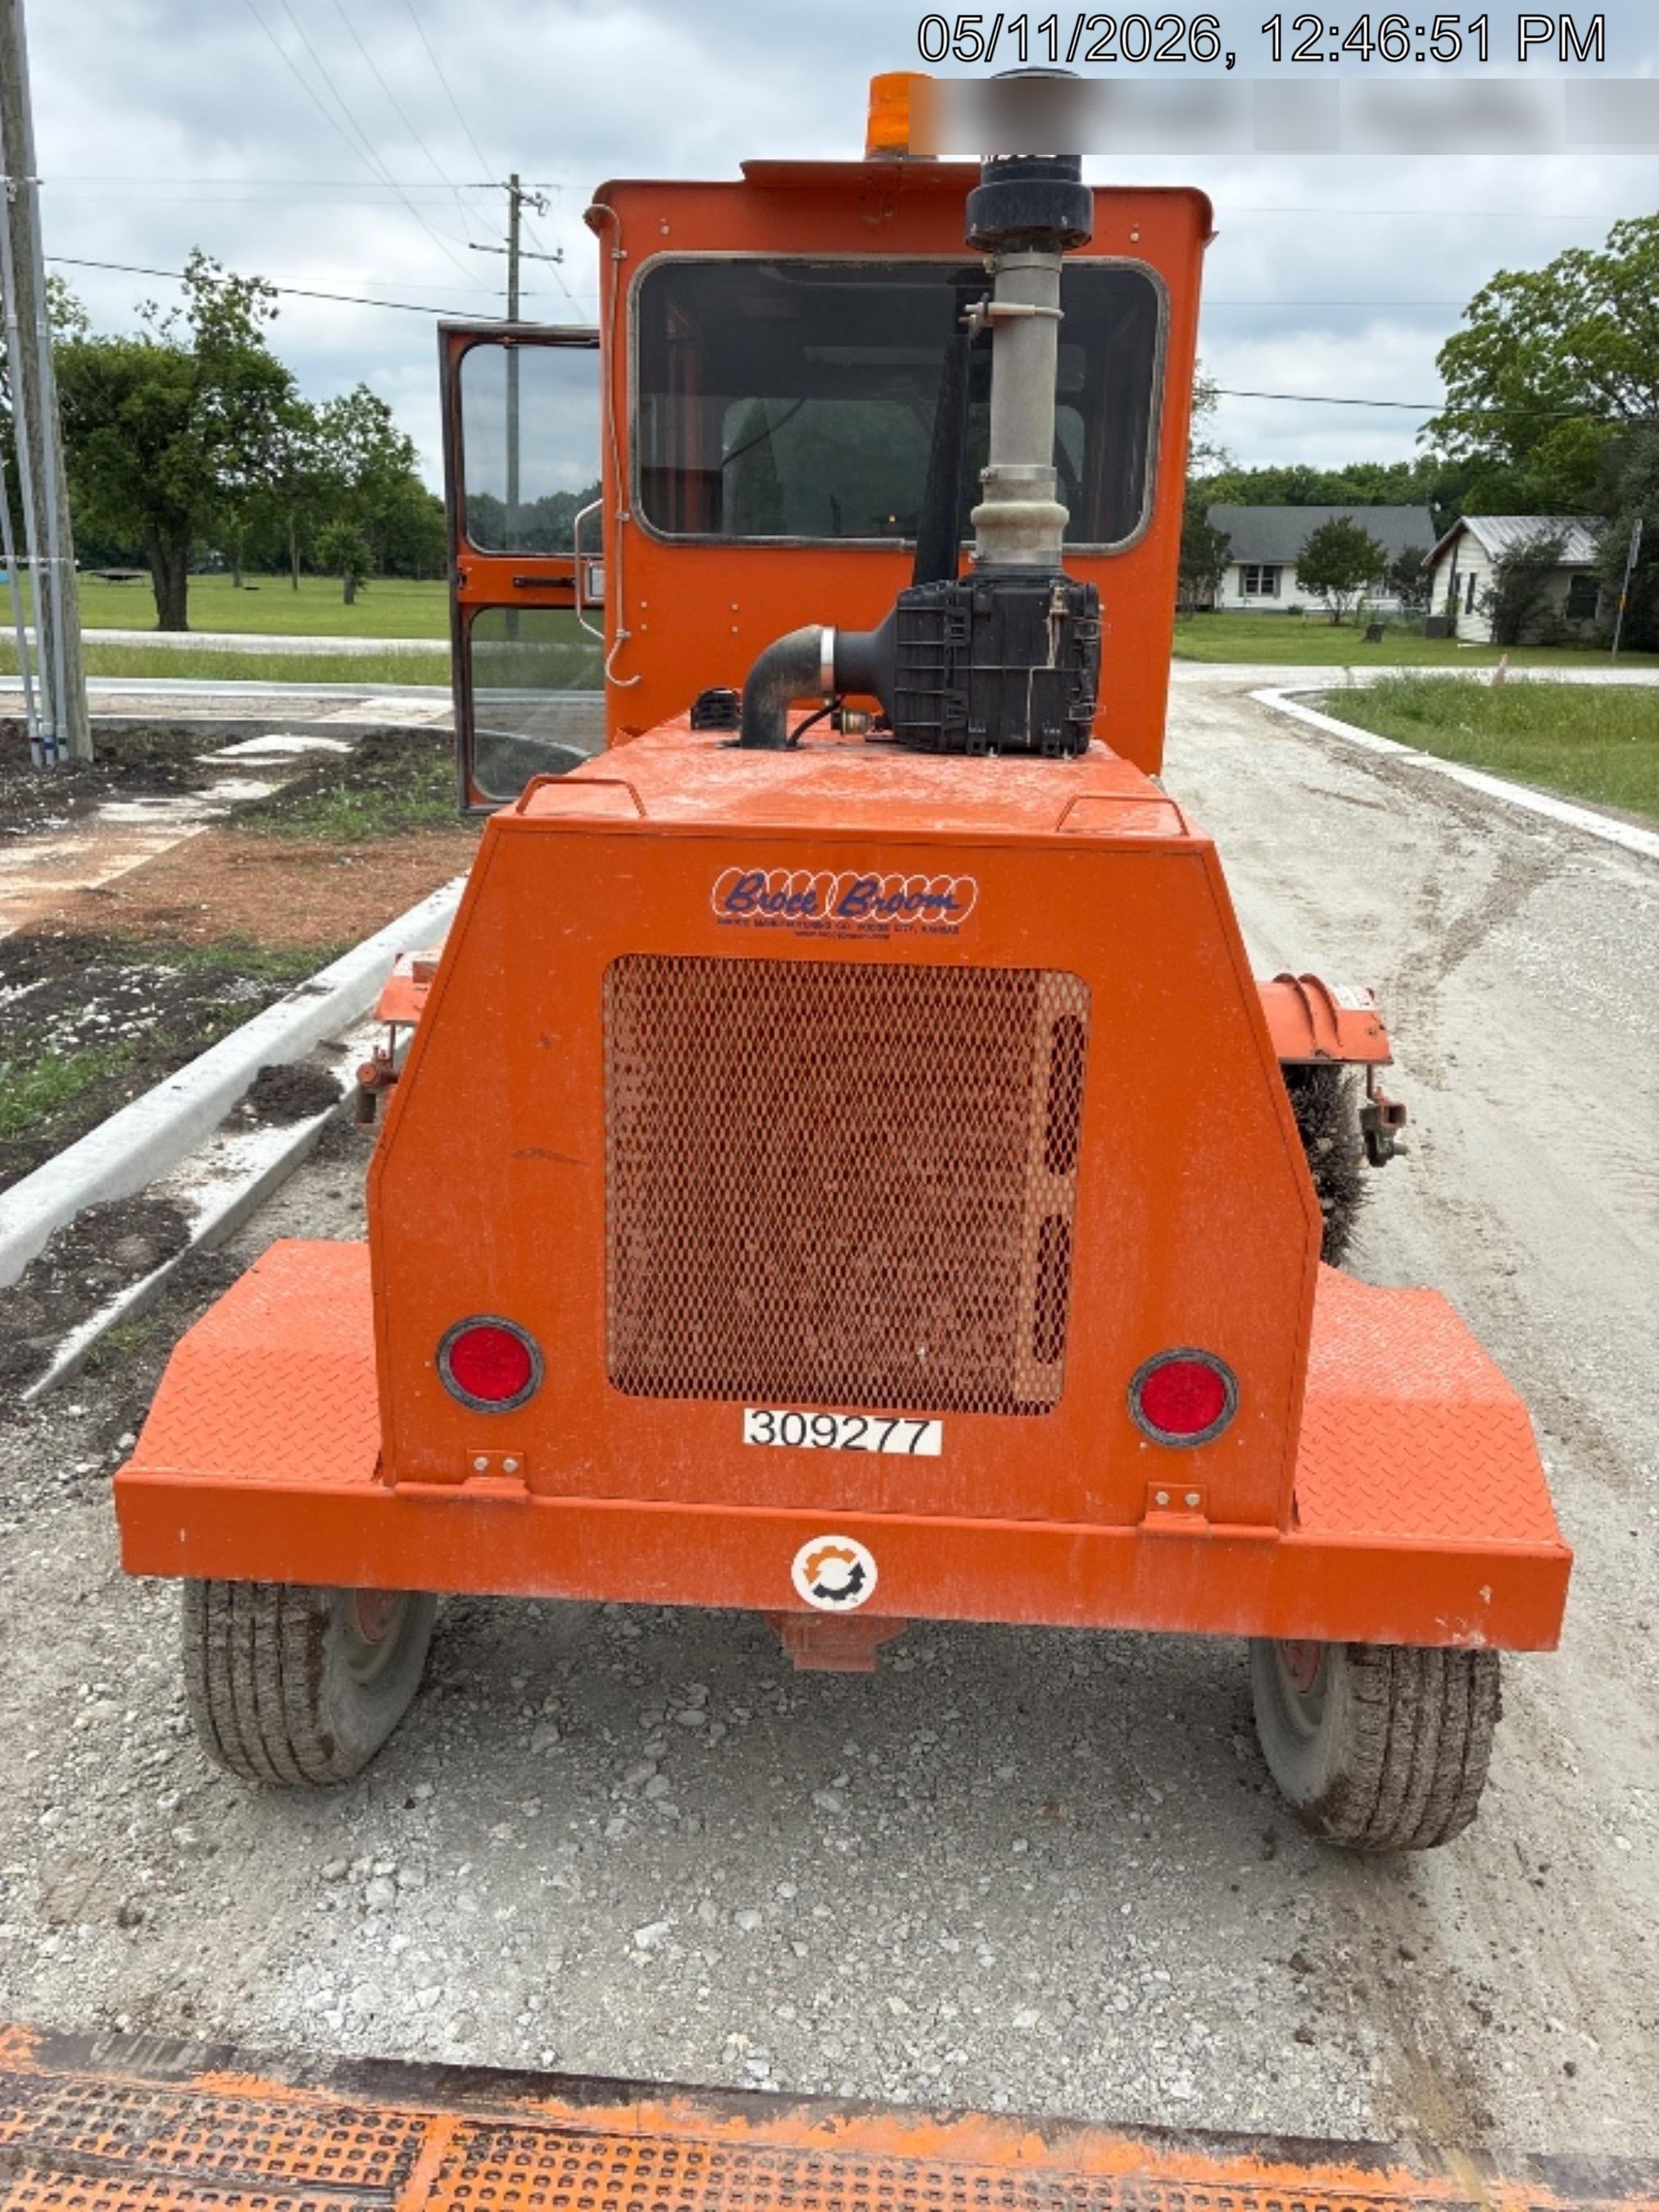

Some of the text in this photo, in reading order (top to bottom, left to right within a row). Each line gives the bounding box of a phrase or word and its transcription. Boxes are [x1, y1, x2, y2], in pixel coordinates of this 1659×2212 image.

[725, 872, 960, 917] Broce Broom
[750, 1410, 931, 1454] 309277
